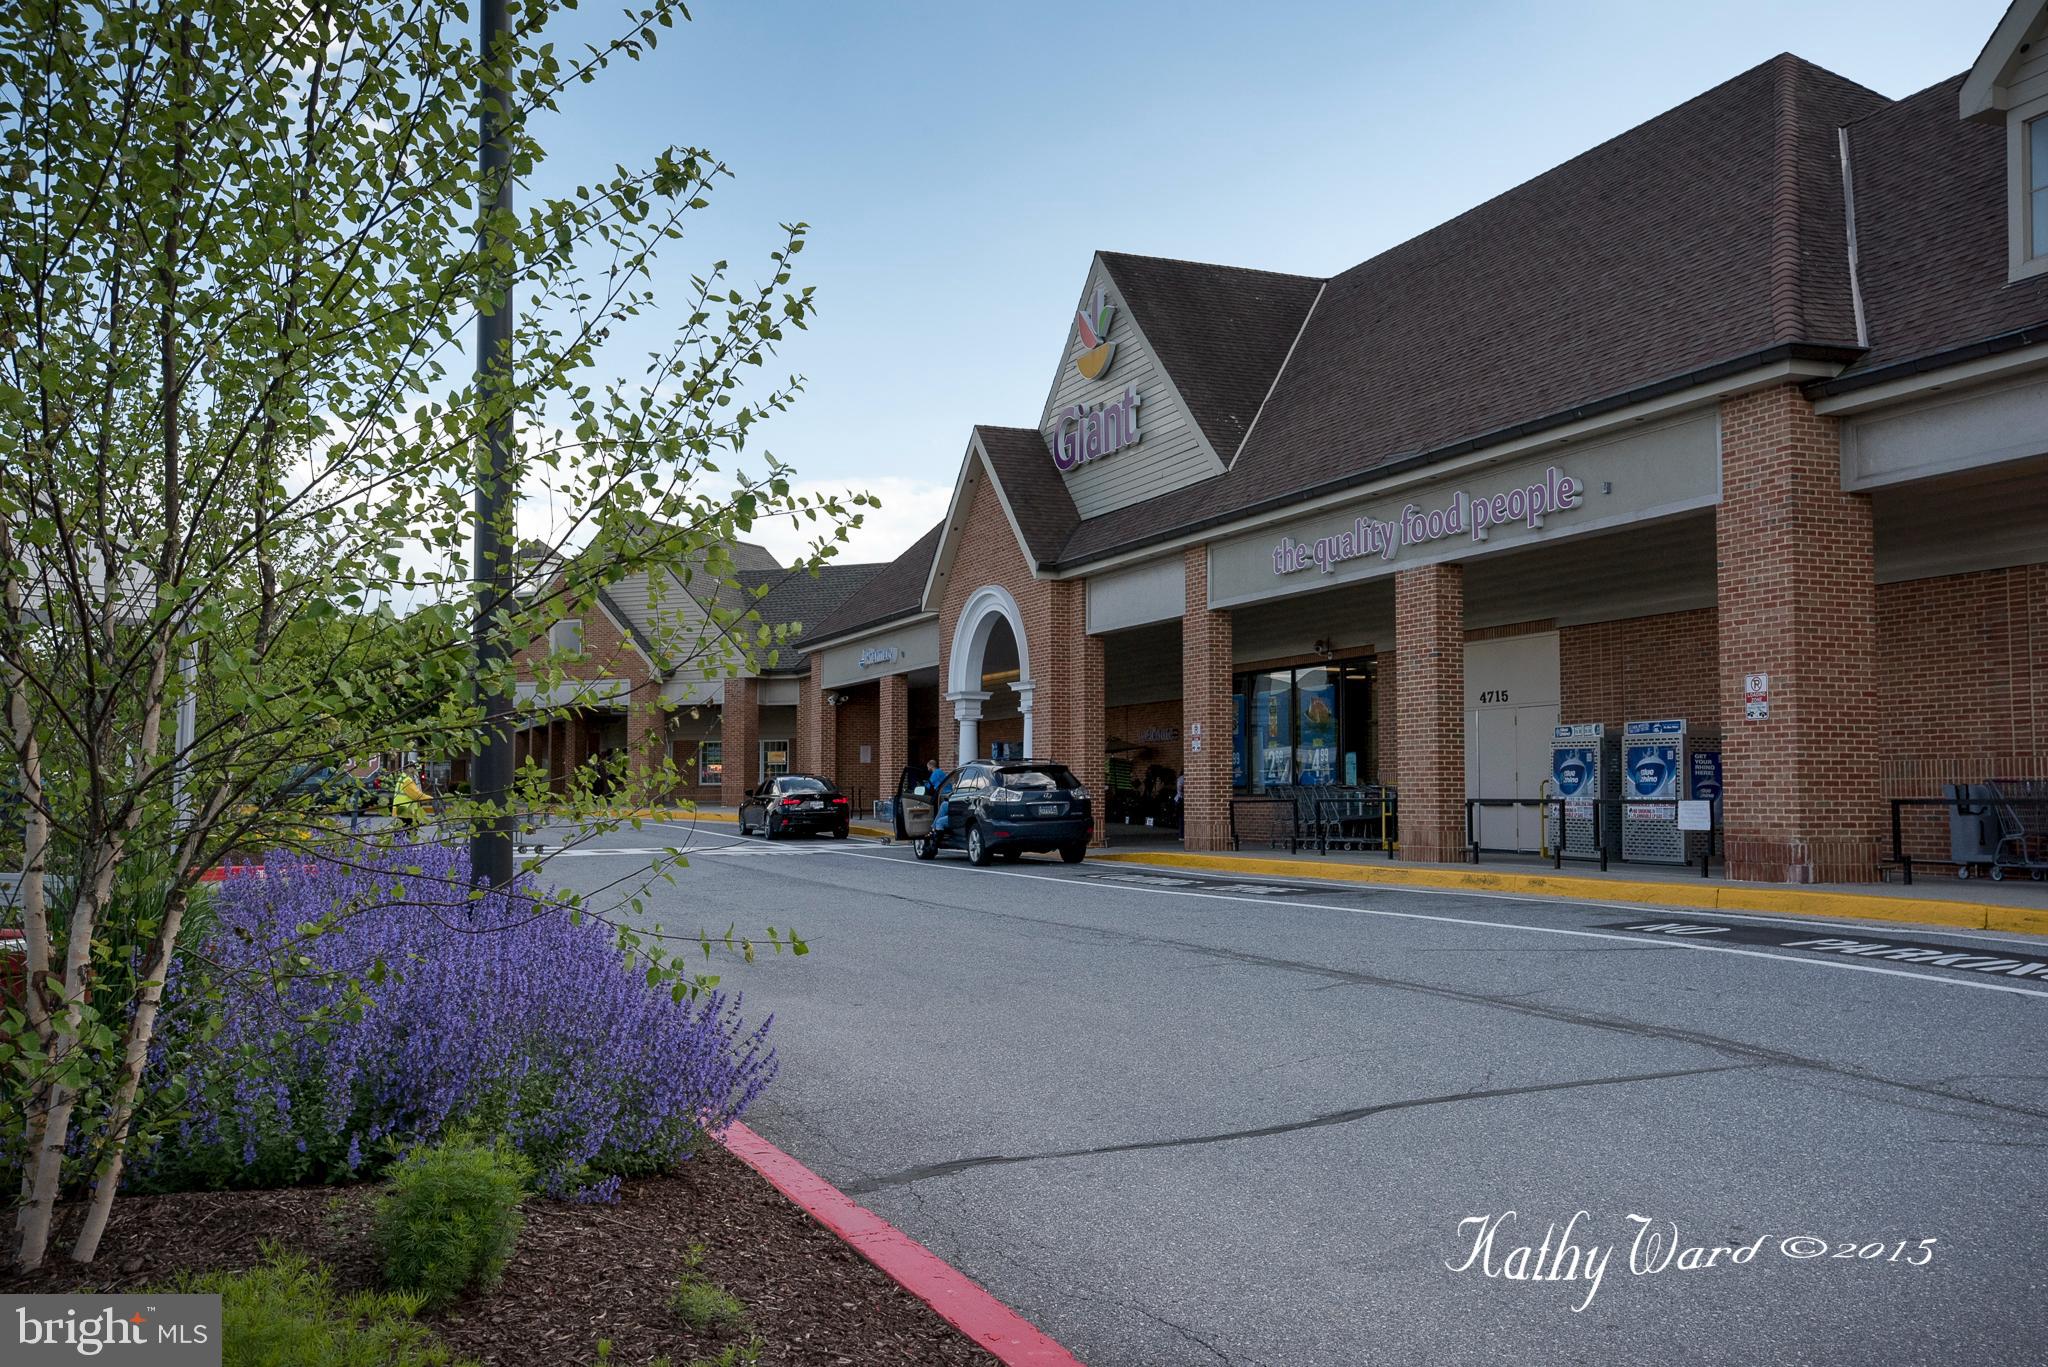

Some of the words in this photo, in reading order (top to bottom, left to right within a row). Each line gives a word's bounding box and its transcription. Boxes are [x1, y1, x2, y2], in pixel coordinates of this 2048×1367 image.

[1053, 382, 1141, 472] Giant
[1273, 538, 1310, 575] the
[1313, 517, 1397, 573] quality
[1401, 491, 1468, 545] food
[1471, 466, 1580, 541] people
[1479, 690, 1509, 704] 4715
[1624, 923, 1731, 935] NO
[1781, 938, 2048, 980] PARKIN
